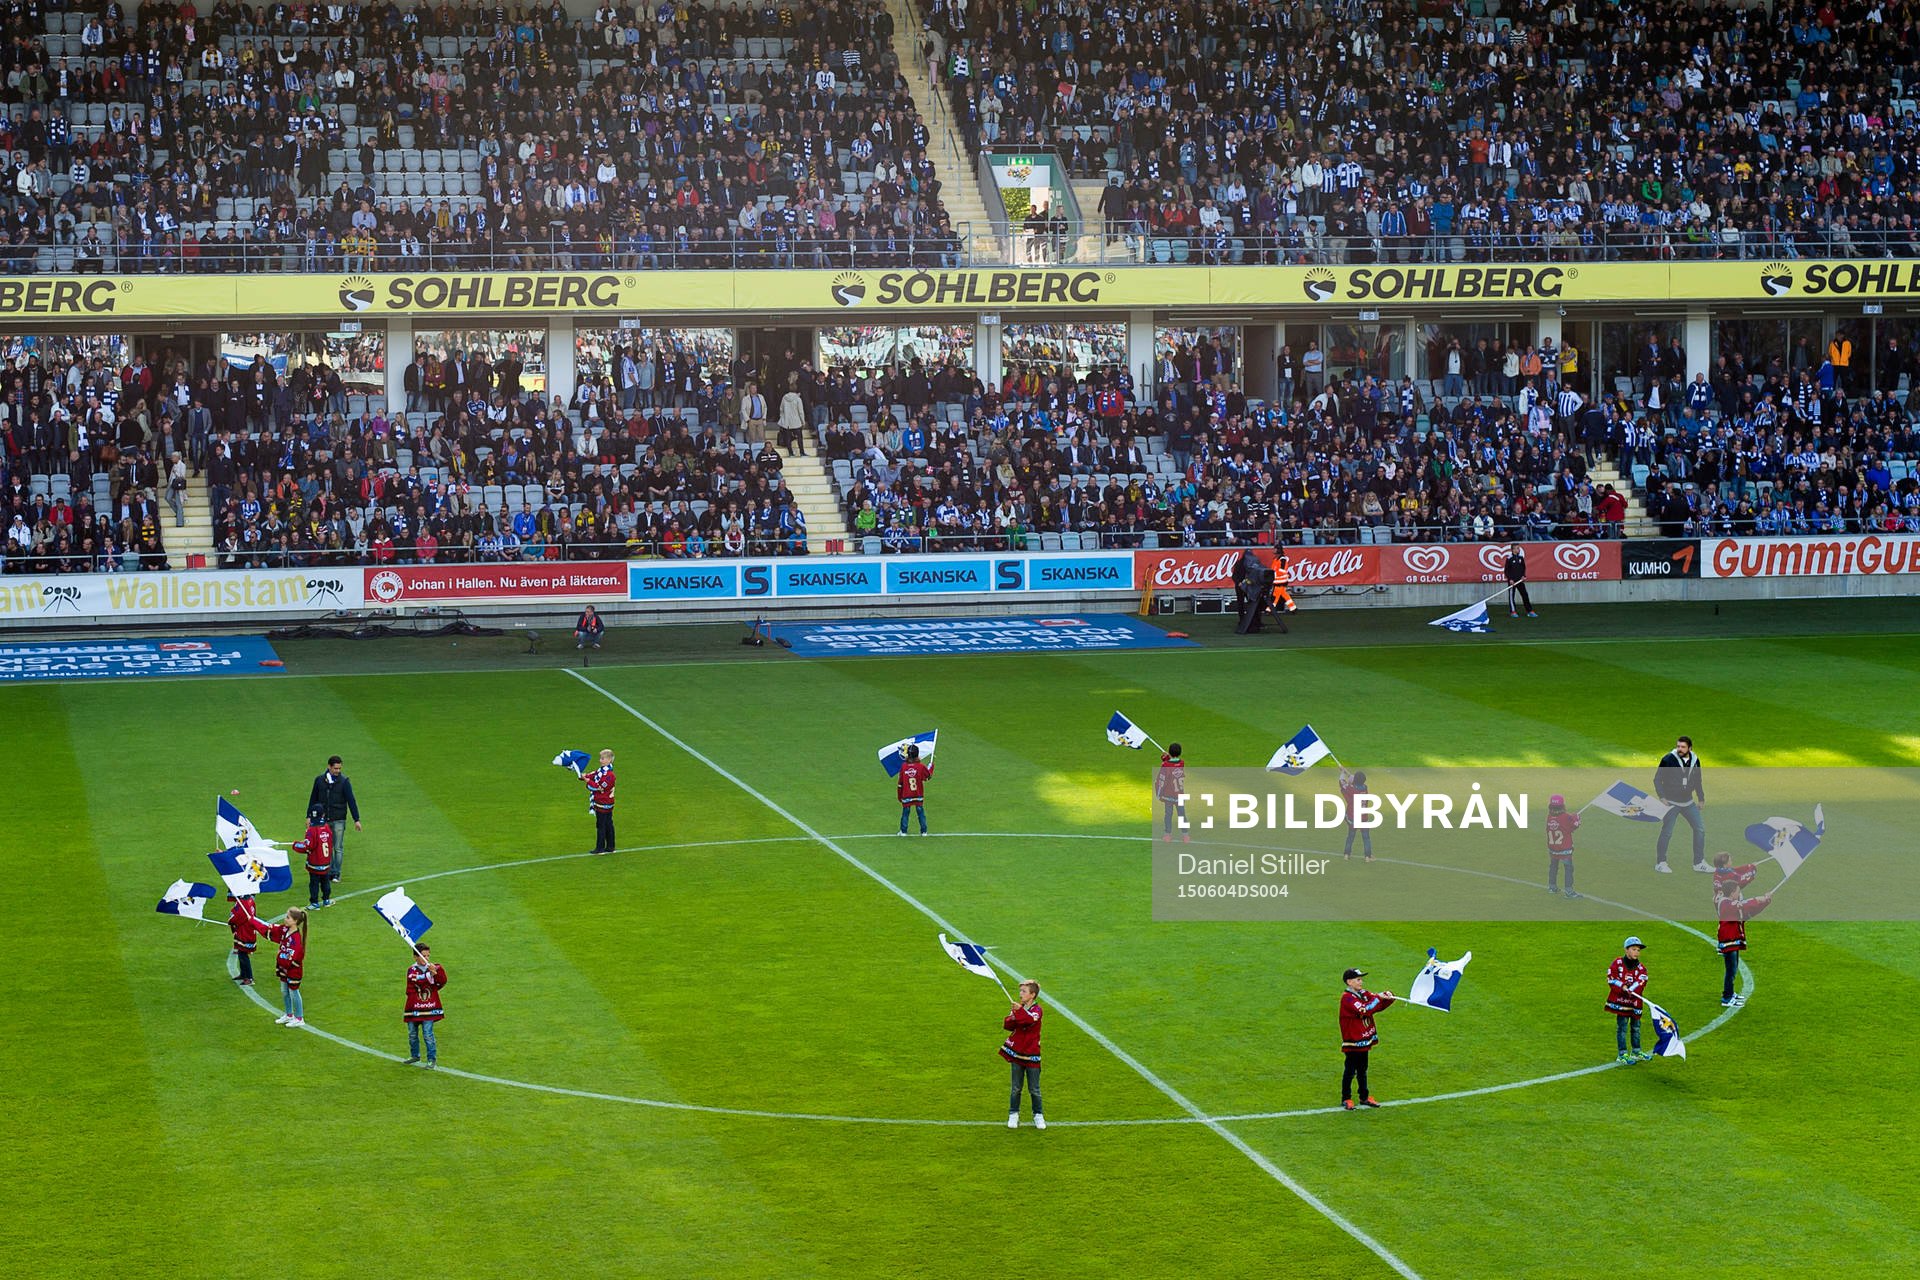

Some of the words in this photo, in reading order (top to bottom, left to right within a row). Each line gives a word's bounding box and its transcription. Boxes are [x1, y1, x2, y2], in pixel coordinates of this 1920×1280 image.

[1155, 551, 1240, 585] Estrell
[1287, 549, 1363, 583] strella
[1629, 562, 1670, 575] KUMHO
[744, 566, 770, 595] S
[789, 572, 868, 587] SKANSKA
[899, 570, 977, 584] SKANSKA
[998, 560, 1022, 589] S
[1041, 567, 1119, 581] SKANSKA
[408, 578, 445, 591] Johan
[456, 577, 497, 590] Hallen.
[500, 577, 517, 589] Nu
[520, 575, 548, 587] även
[551, 575, 566, 589] på
[570, 574, 621, 587] läktaren.
[643, 575, 724, 590] SKANSKA
[106, 574, 309, 609] Wallenstam
[909, 777, 917, 791] 8
[1548, 830, 1563, 845] 12
